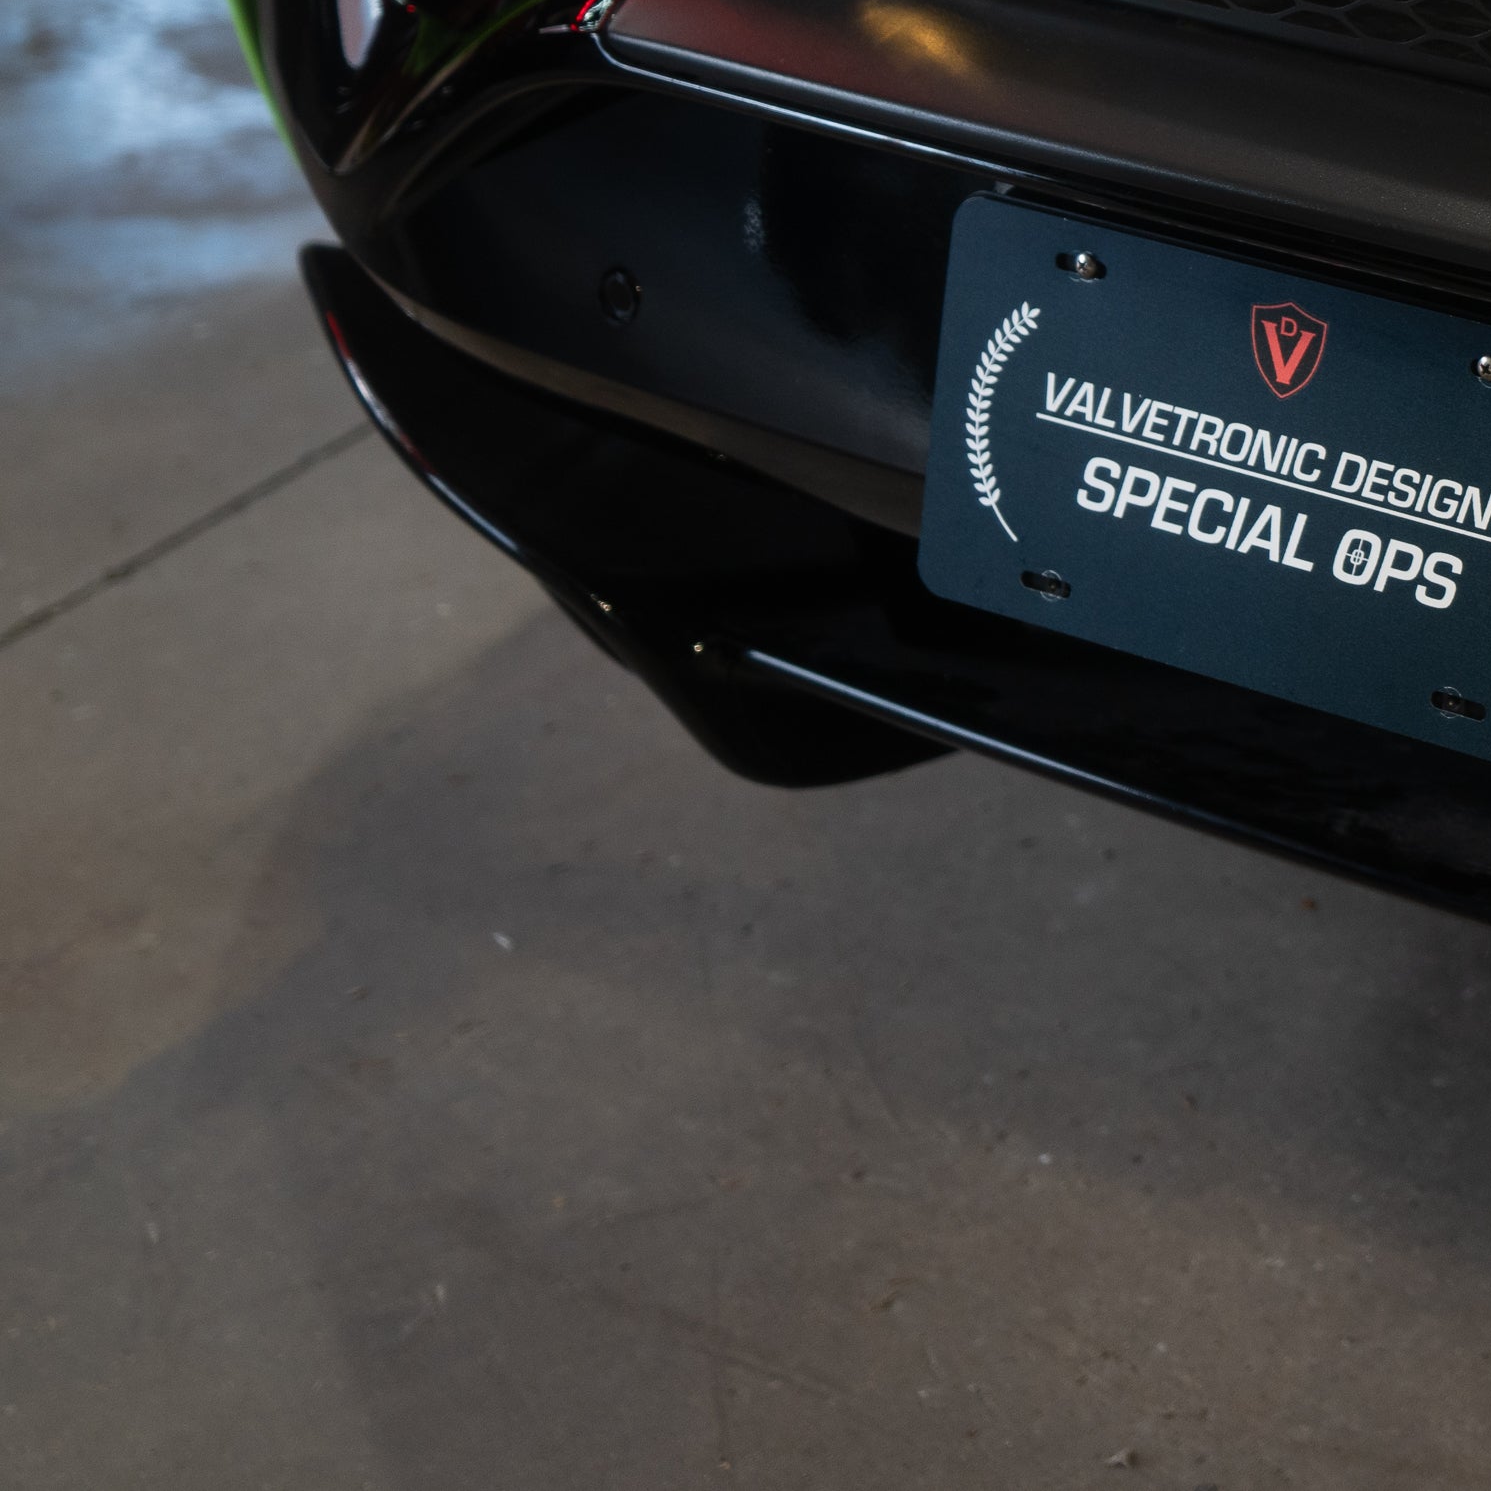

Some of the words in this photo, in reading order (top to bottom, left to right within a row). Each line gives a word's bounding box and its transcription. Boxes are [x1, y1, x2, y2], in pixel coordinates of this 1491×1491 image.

[1045, 371, 1327, 483] VALVETRONIC
[1076, 456, 1314, 573] SPECIAL
[1333, 528, 1464, 609] OPS
